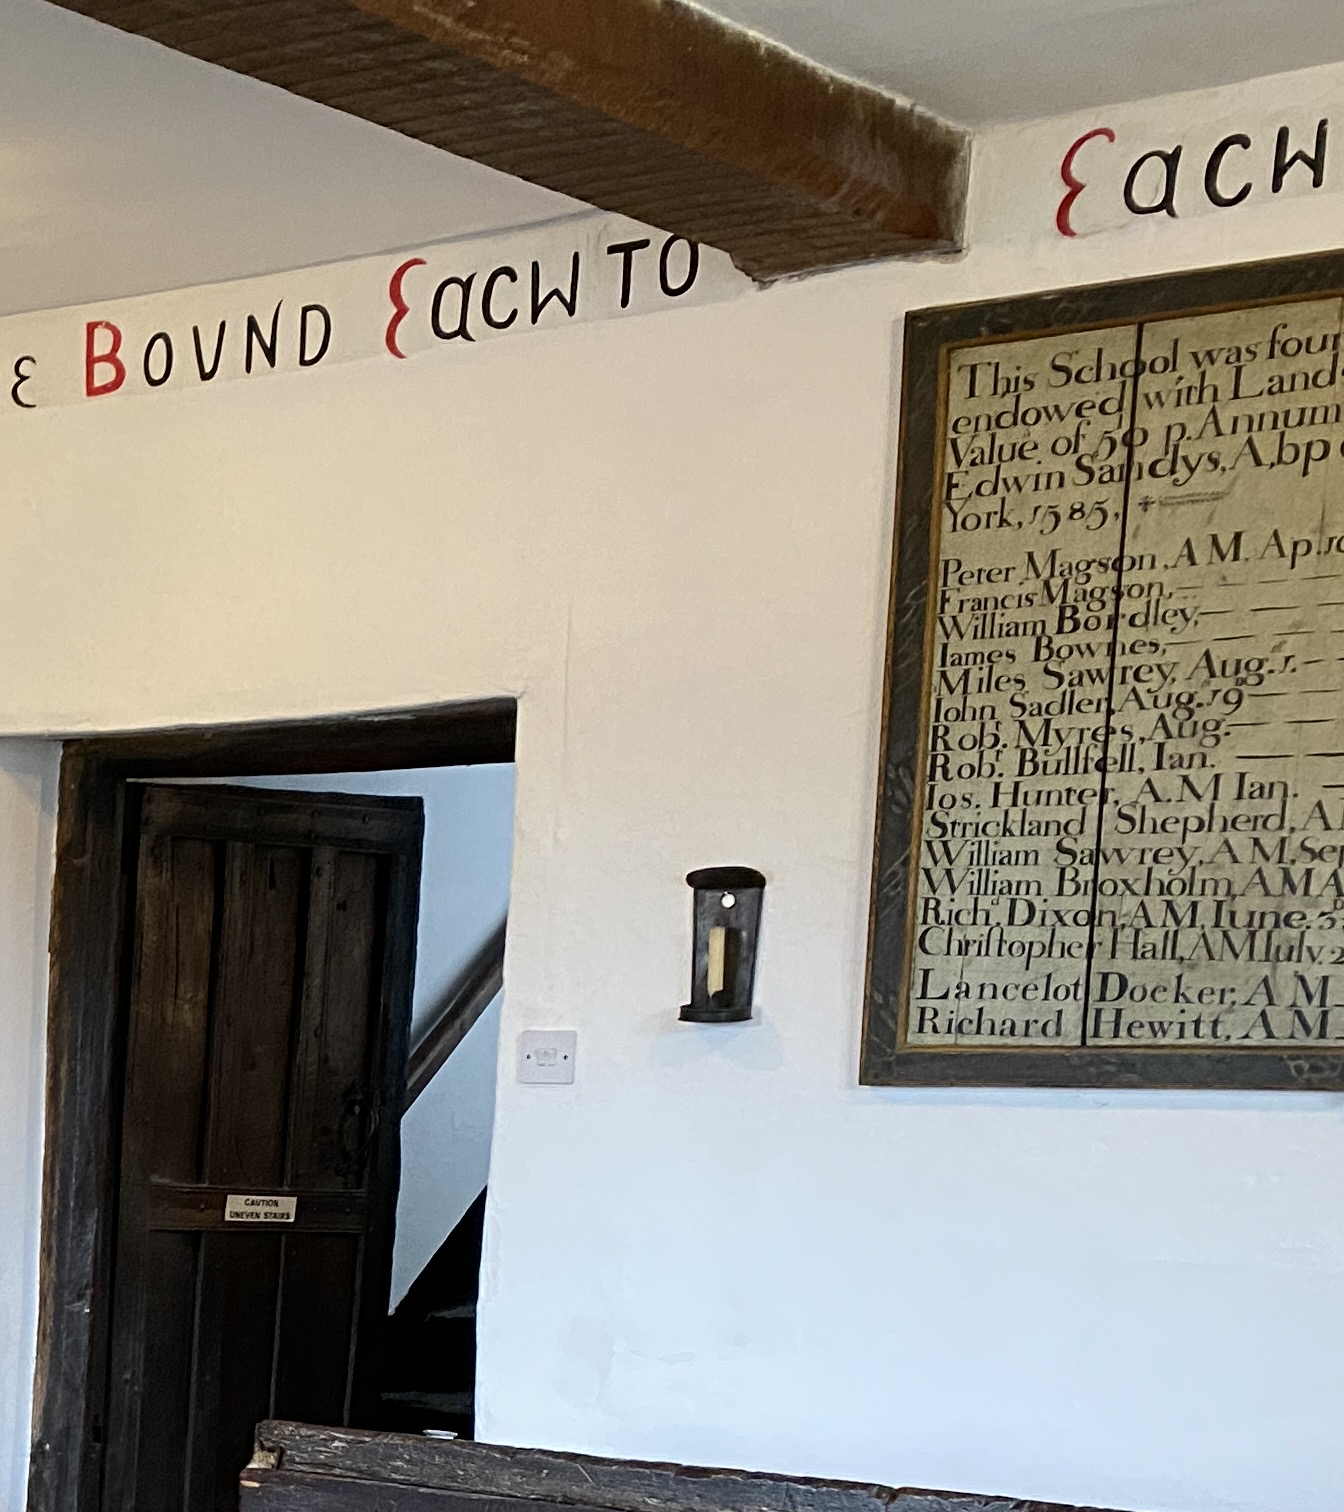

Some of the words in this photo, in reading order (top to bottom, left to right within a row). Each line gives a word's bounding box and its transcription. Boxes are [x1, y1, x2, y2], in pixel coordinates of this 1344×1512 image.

[608, 233, 700, 309] TO
[957, 360, 1040, 400] This
[1049, 337, 1180, 388] School
[1189, 340, 1263, 369] was
[951, 380, 1127, 435] endowed
[1144, 369, 1219, 410] with
[1050, 420, 1092, 456] of
[944, 464, 1066, 502] Edwin
[943, 496, 1024, 534] York,
[939, 557, 1017, 590] Peter
[938, 588, 1039, 615] Francis
[937, 611, 1047, 642] William
[935, 665, 1027, 698] Miles
[926, 804, 1086, 839] Strickland
[923, 838, 1040, 868] William
[921, 866, 1043, 897] William
[915, 967, 1084, 1002] Lancelot
[915, 1005, 1064, 1038] Richard
[244, 1198, 279, 1207] CAUTION
[263, 1211, 291, 1220] STAIRS
